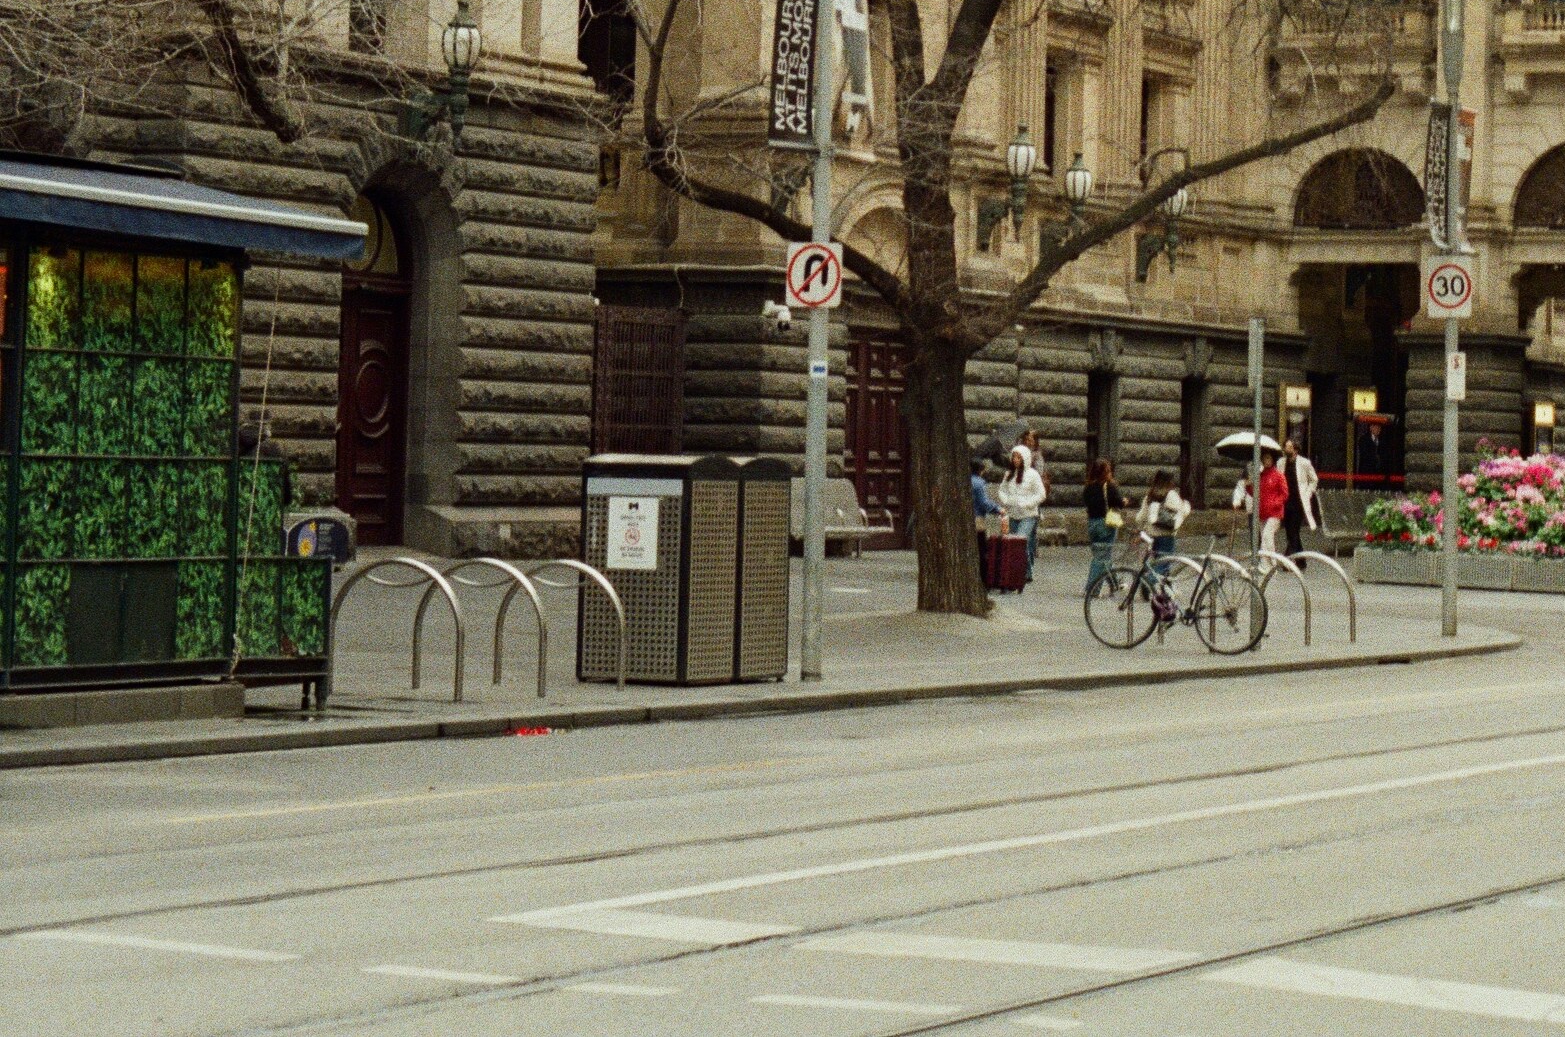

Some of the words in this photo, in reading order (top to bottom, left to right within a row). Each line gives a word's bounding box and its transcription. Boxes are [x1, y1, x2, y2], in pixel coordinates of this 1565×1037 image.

[787, 51, 800, 91] ITS
[785, 102, 798, 132] AT
[1436, 275, 1465, 297] 30
